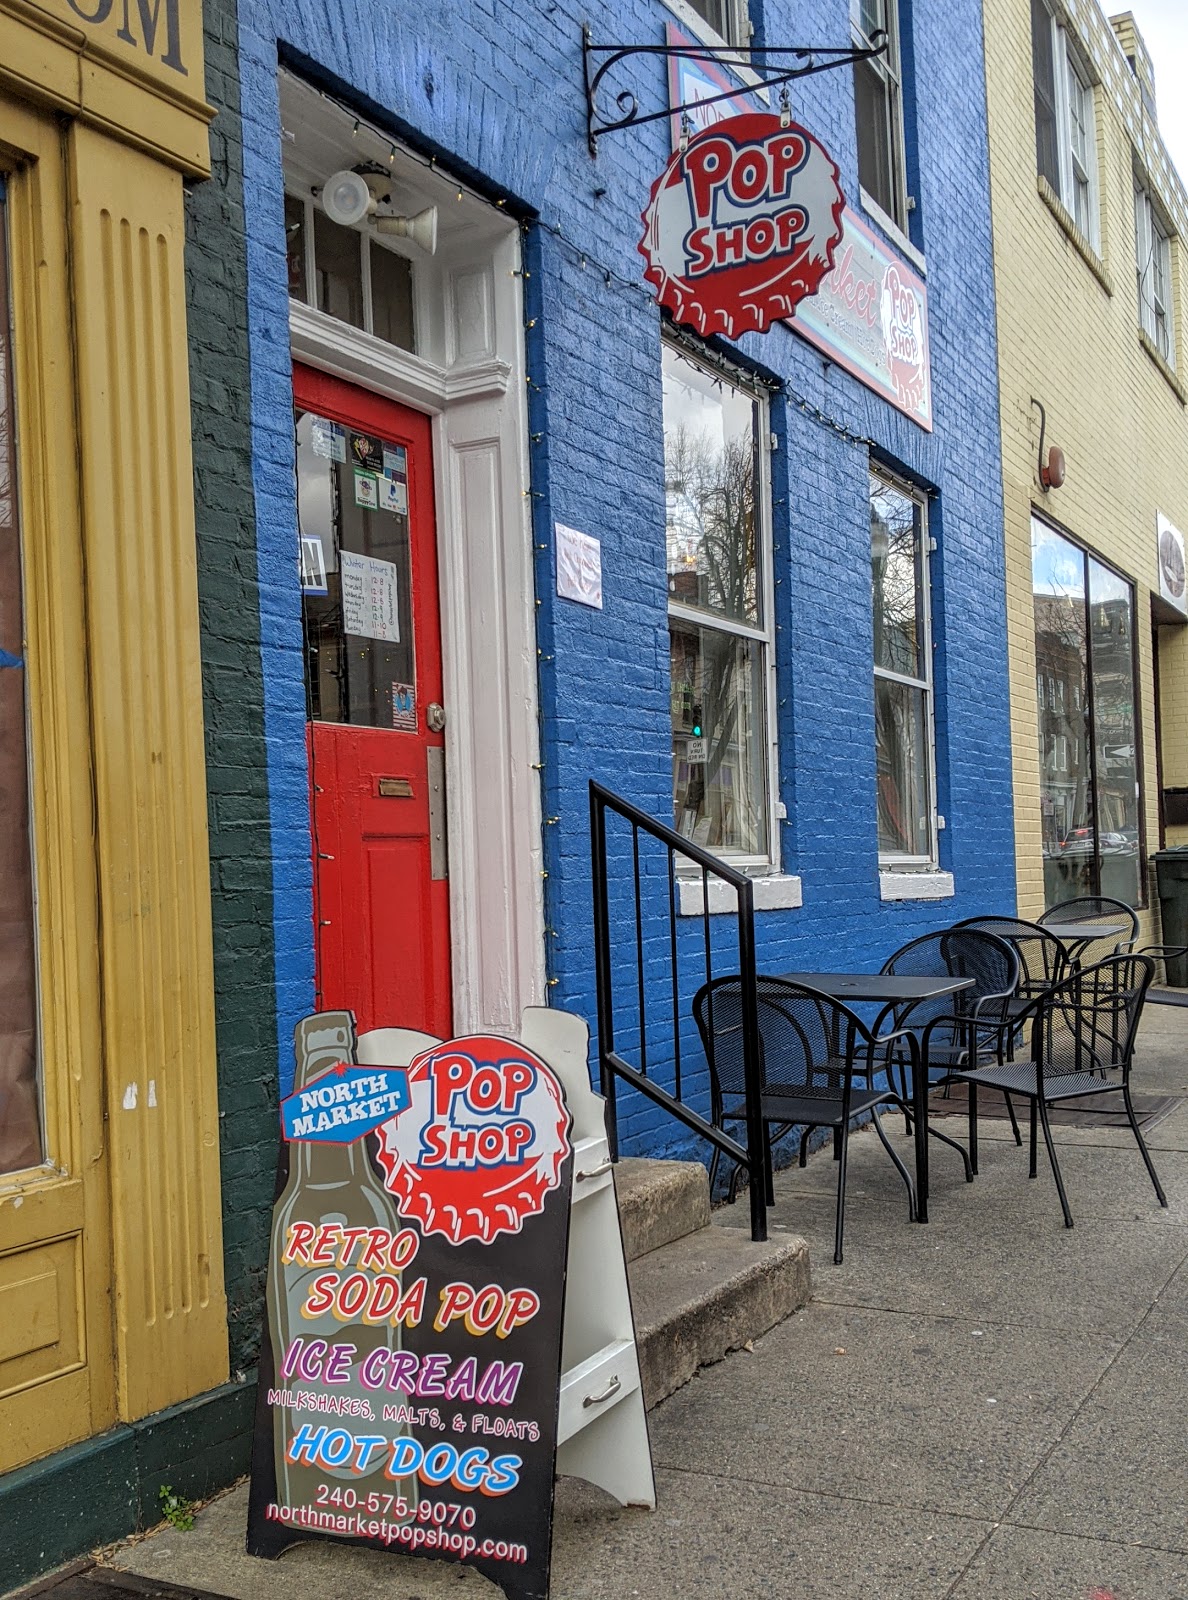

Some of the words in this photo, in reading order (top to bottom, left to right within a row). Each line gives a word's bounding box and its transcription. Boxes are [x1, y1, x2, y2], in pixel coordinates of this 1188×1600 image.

[682, 131, 810, 220] POP
[684, 205, 809, 279] SHOP
[888, 266, 917, 331] POP
[890, 325, 917, 361] SHOP
[344, 556, 365, 570] Winter
[369, 561, 388, 576] Hours
[300, 1073, 388, 1113] NORTH
[431, 1053, 536, 1115] POP
[292, 1091, 401, 1137] MARKET
[421, 1121, 535, 1168] SHOP
[282, 1221, 419, 1274] RETRO
[302, 1273, 427, 1328] SODA
[433, 1282, 540, 1338] POP
[281, 1338, 357, 1385] ICE
[360, 1347, 523, 1406] CREAM
[268, 1389, 376, 1421] MILKSHAKES,
[383, 1405, 445, 1430] MALTS,
[452, 1415, 466, 1432] &
[472, 1414, 540, 1441] FLOATS
[285, 1424, 386, 1474] HOT
[385, 1436, 523, 1497] DOGS
[266, 1503, 527, 1563] northmarketpopshop.com
[315, 1484, 477, 1531] 240-575-9070
